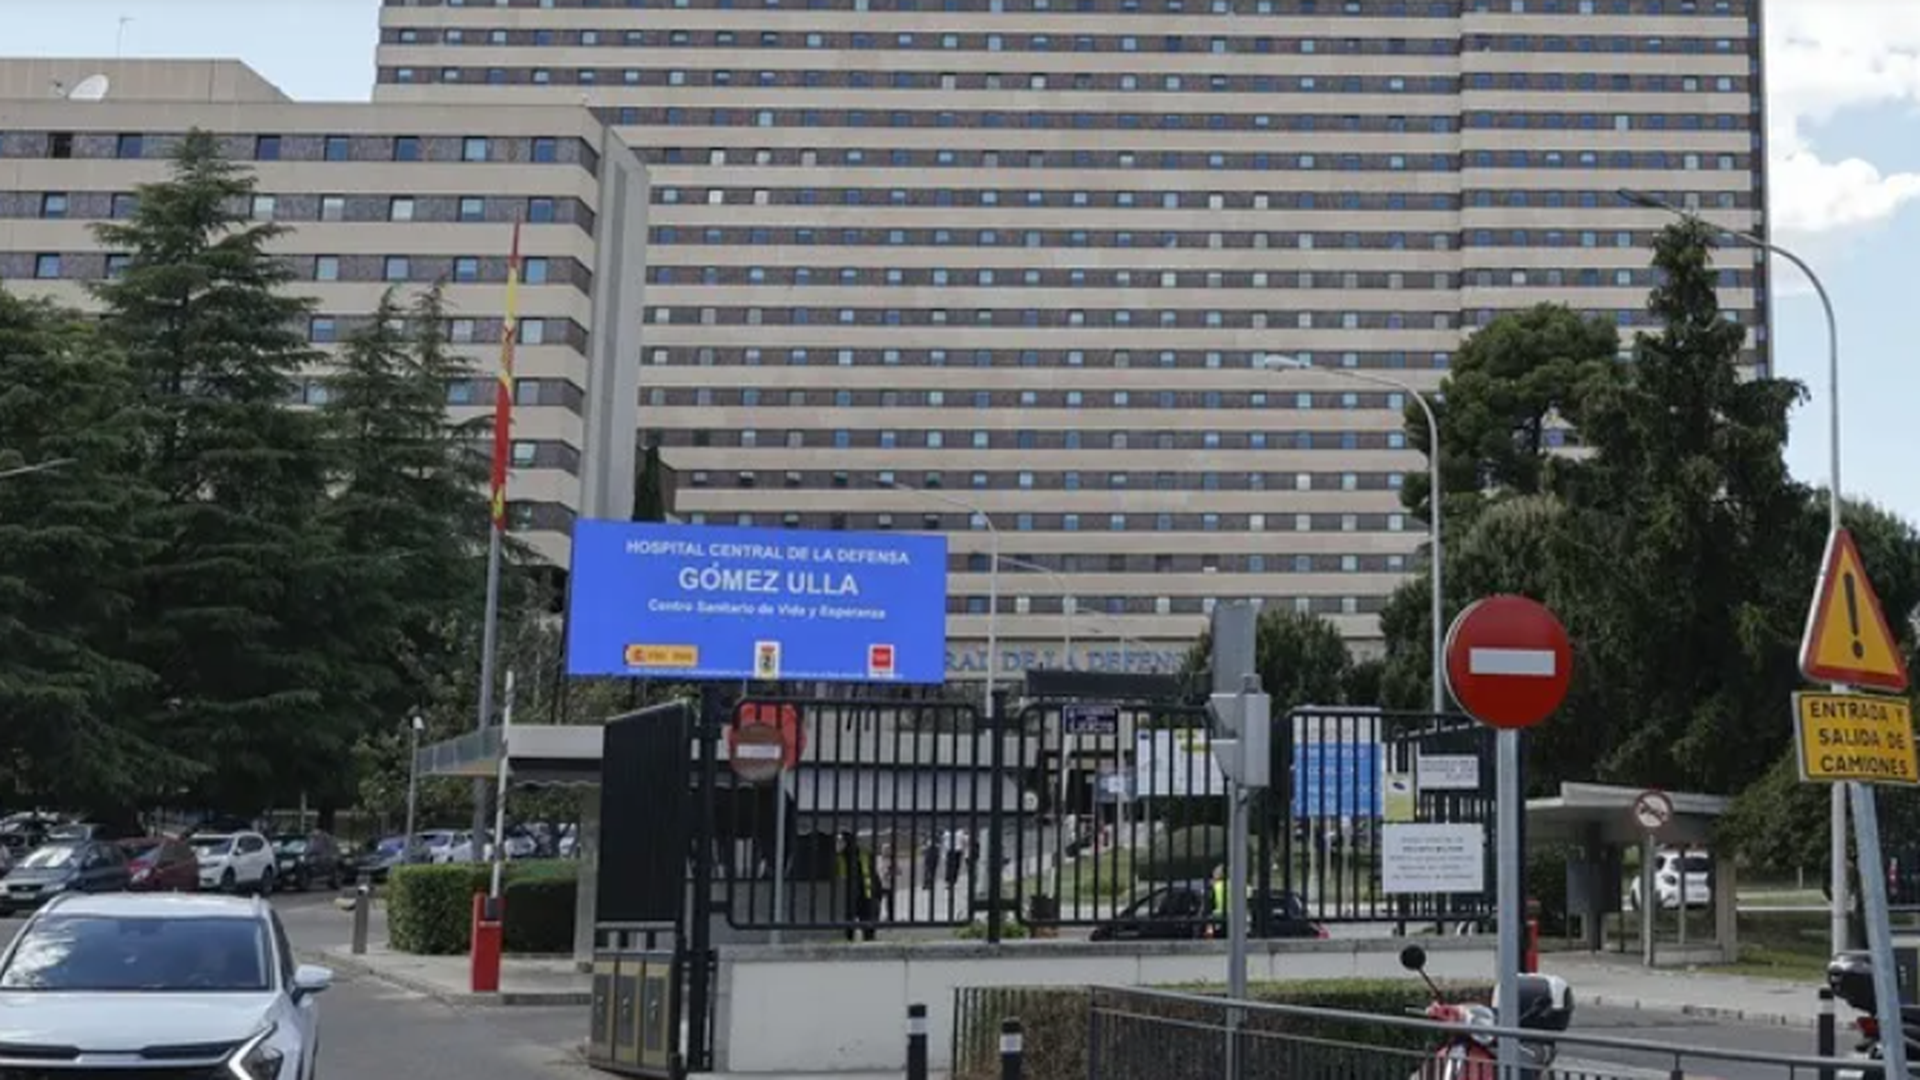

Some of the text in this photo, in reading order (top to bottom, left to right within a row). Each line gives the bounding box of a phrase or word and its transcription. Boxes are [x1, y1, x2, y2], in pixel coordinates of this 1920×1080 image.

[626, 540, 909, 565] HOSPITAL CENTRAL DE LA DEFENSA
[678, 562, 860, 596] GÓMEZ ULLA
[648, 598, 886, 621] Centro Sanitario de Vida y Esperanza
[1003, 649, 1039, 671] DE
[1087, 649, 1184, 672] DEFENS
[1810, 701, 1905, 724] ENTRADA Y
[1818, 728, 1906, 750] SALIDA DE
[1820, 756, 1909, 776] CAMIONES
